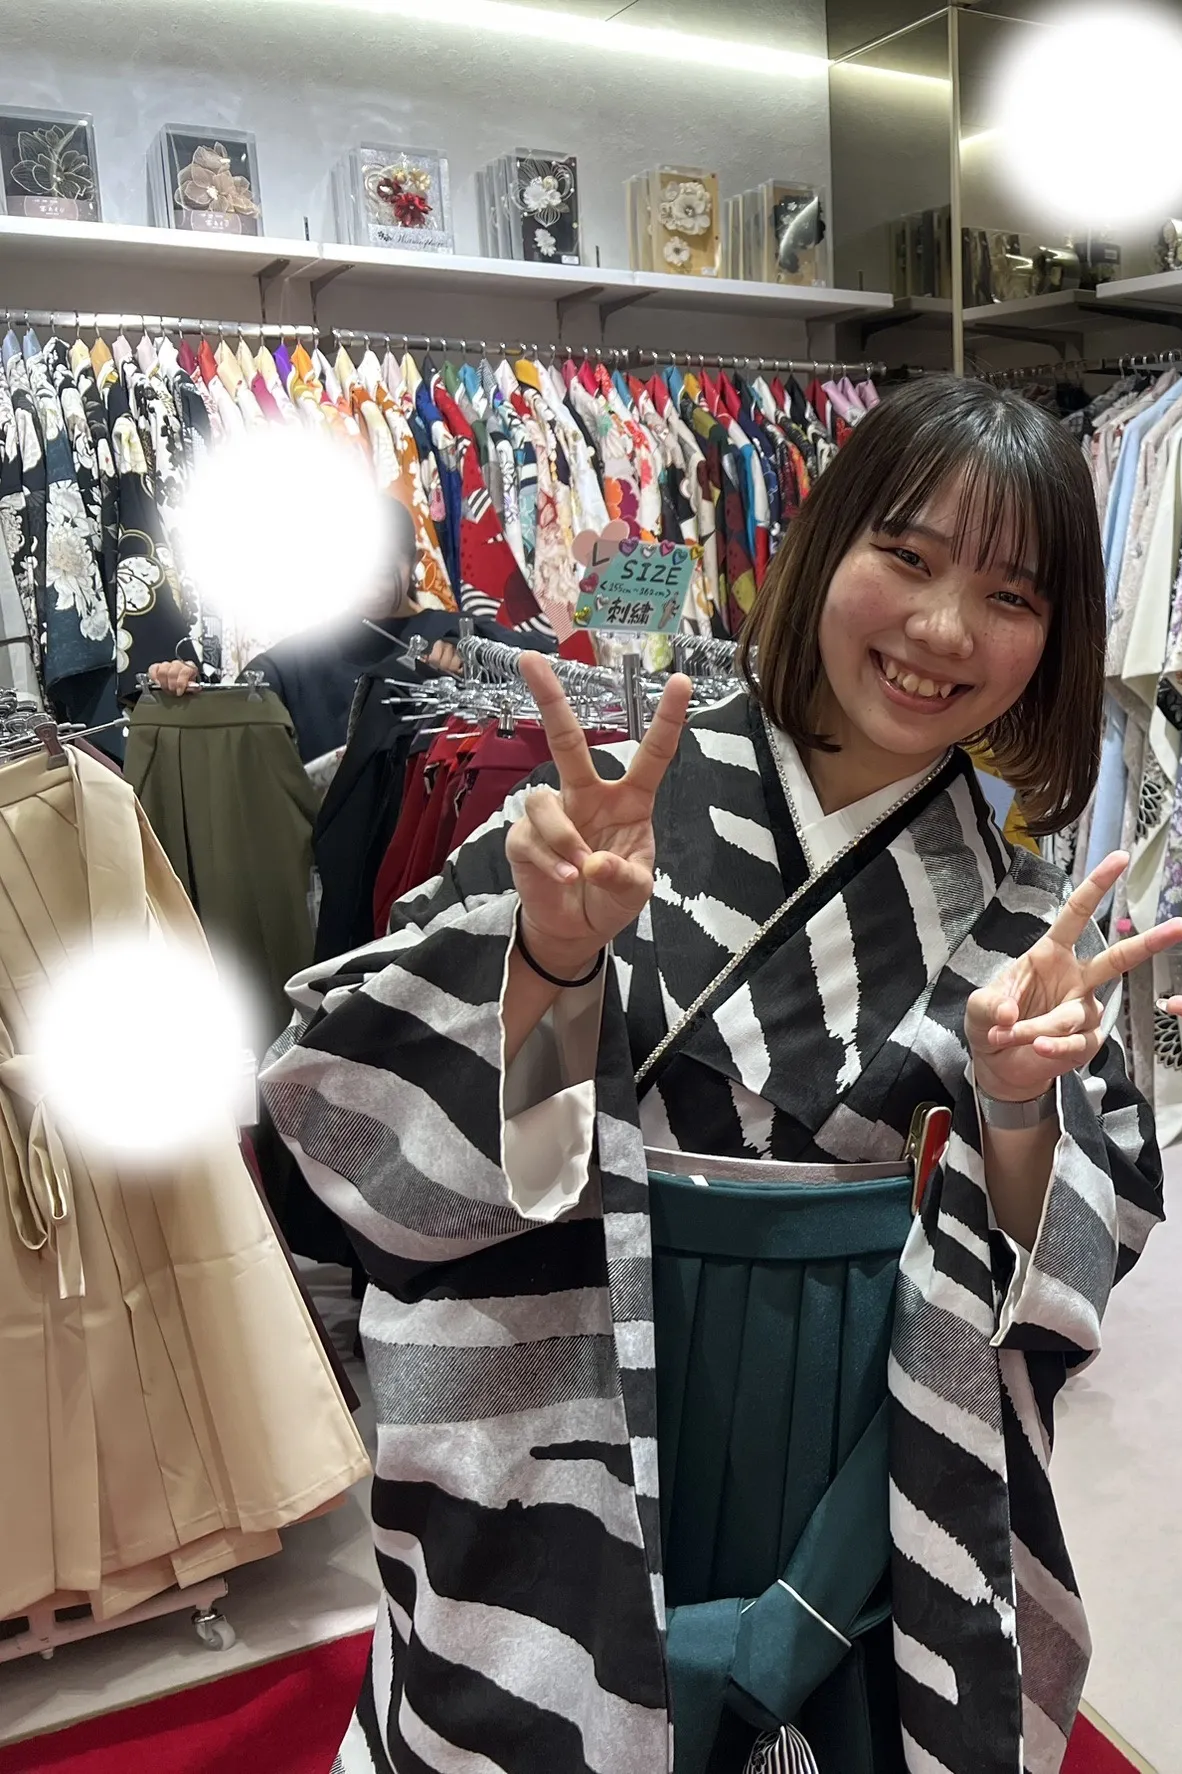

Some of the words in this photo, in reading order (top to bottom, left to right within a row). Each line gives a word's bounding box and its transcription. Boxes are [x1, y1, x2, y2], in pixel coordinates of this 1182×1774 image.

[592, 542, 610, 566] L
[621, 559, 682, 586] SIZE
[606, 596, 654, 625] 刺繍
